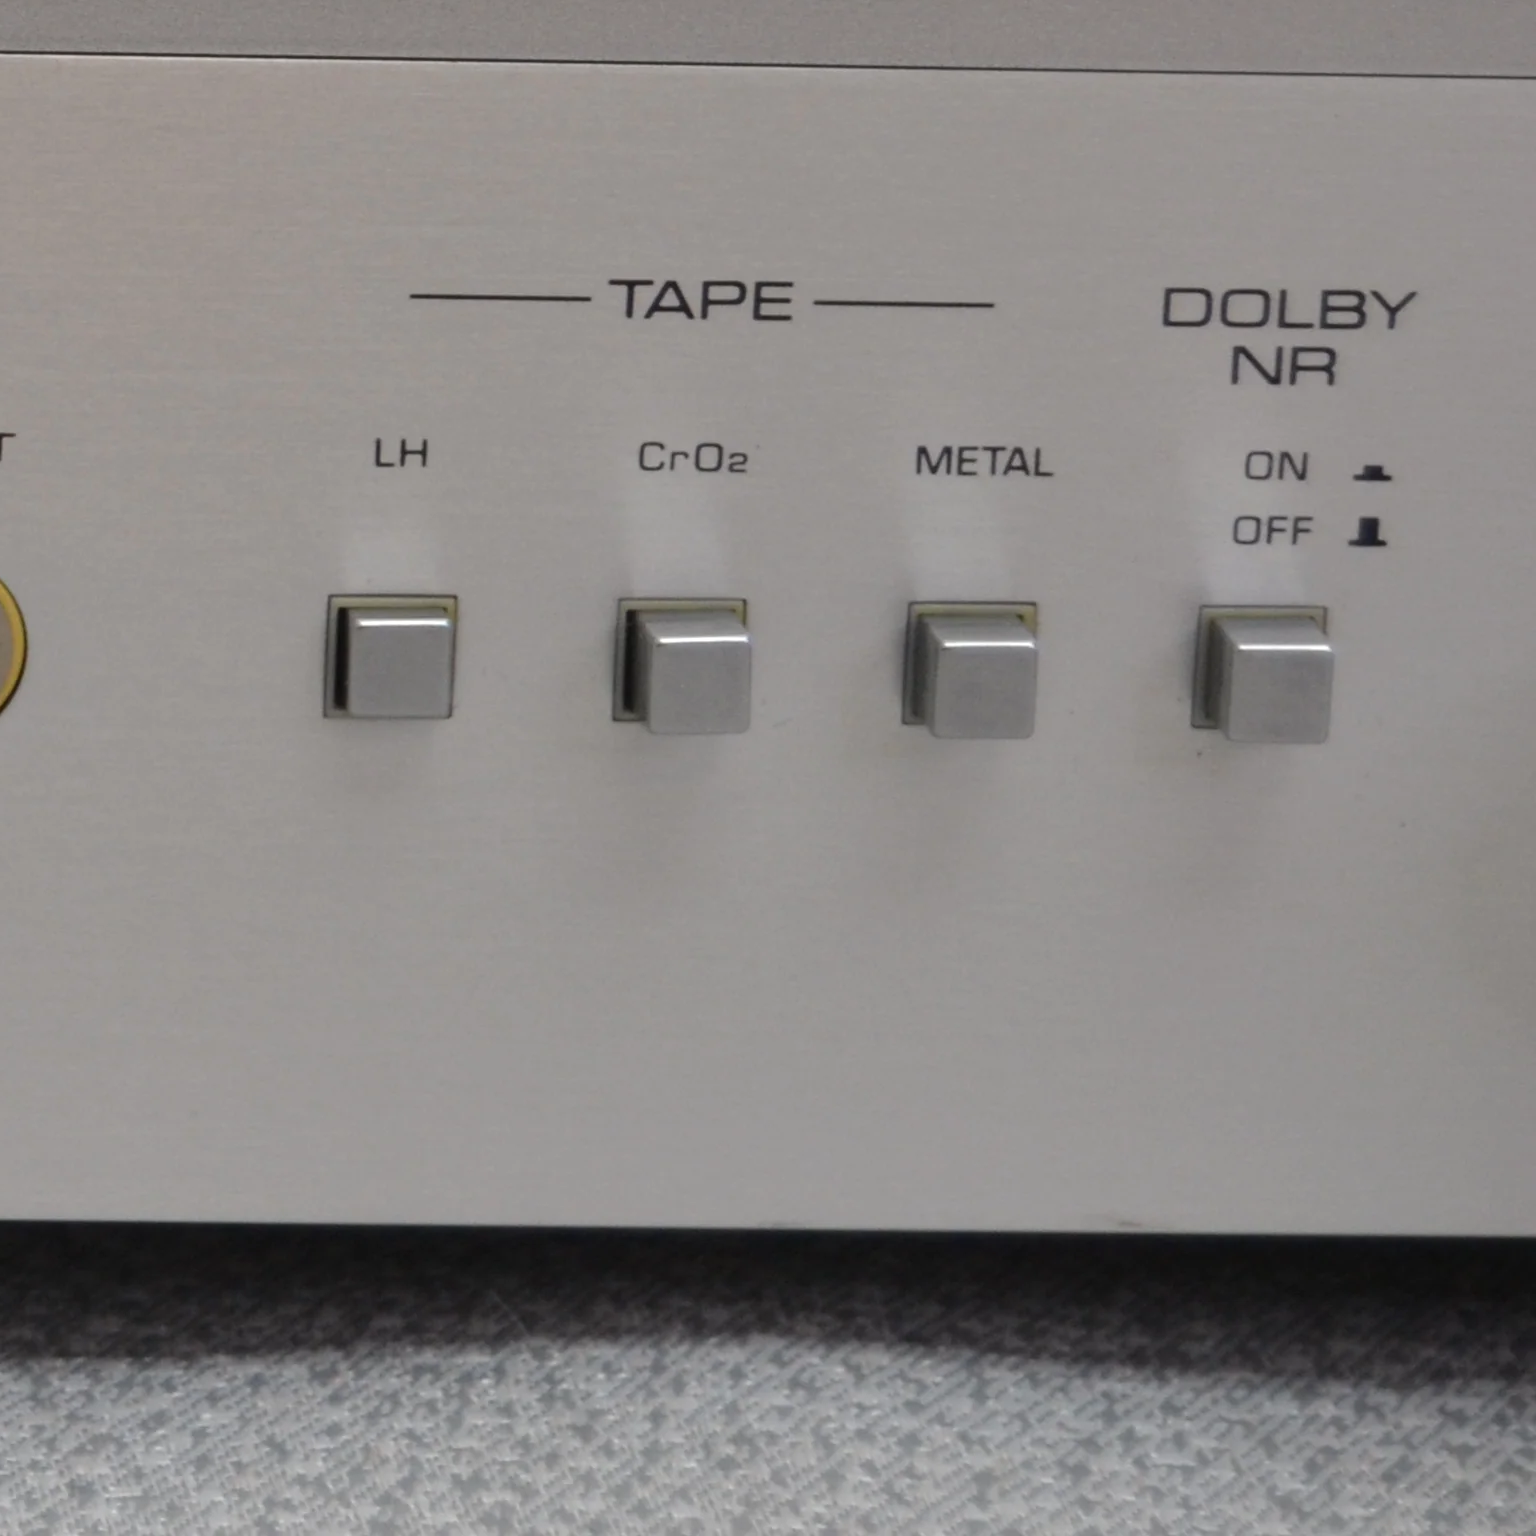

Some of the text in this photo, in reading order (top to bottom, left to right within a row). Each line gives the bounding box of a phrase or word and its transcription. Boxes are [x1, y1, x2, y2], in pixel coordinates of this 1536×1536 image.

[608, 279, 794, 322] TAPE
[1162, 287, 1417, 331] DOLBY
[1231, 345, 1337, 386] NR
[374, 438, 428, 468] LH
[916, 445, 1054, 478] METAL
[1244, 450, 1309, 482] ON
[1232, 515, 1314, 546] OFF
